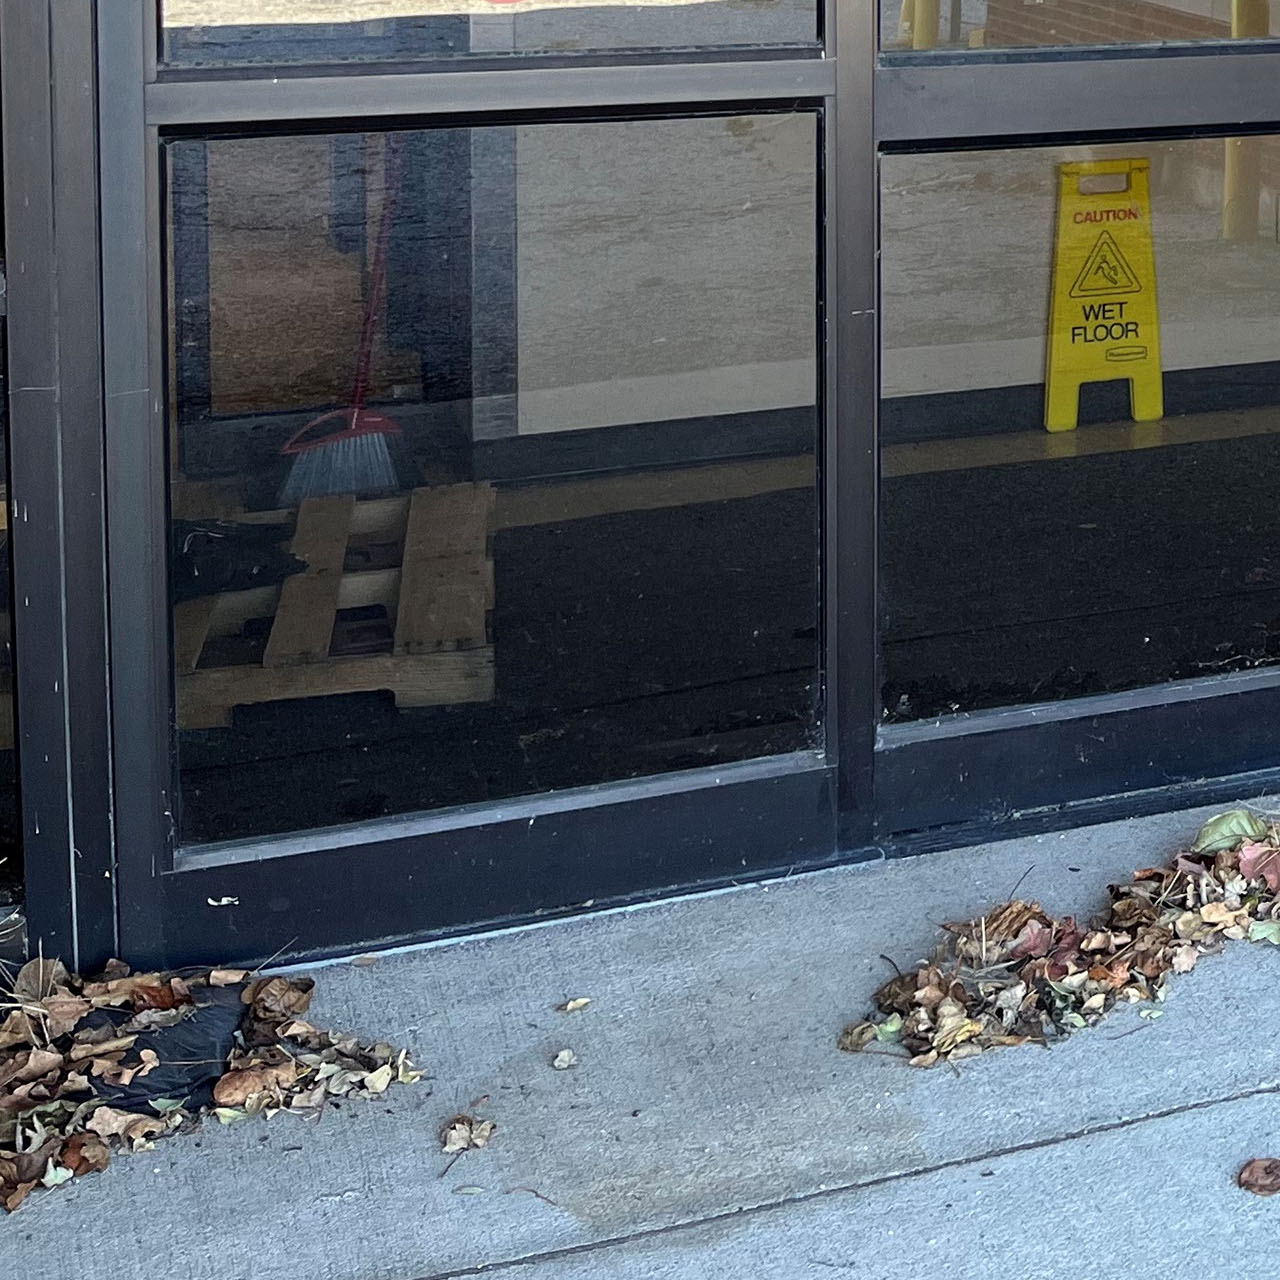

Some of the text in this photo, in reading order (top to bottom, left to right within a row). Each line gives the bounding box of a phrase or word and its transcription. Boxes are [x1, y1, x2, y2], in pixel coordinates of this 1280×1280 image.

[1073, 207, 1141, 224] CAUTION
[1082, 302, 1128, 322] WET
[1071, 322, 1140, 344] FLOOR
